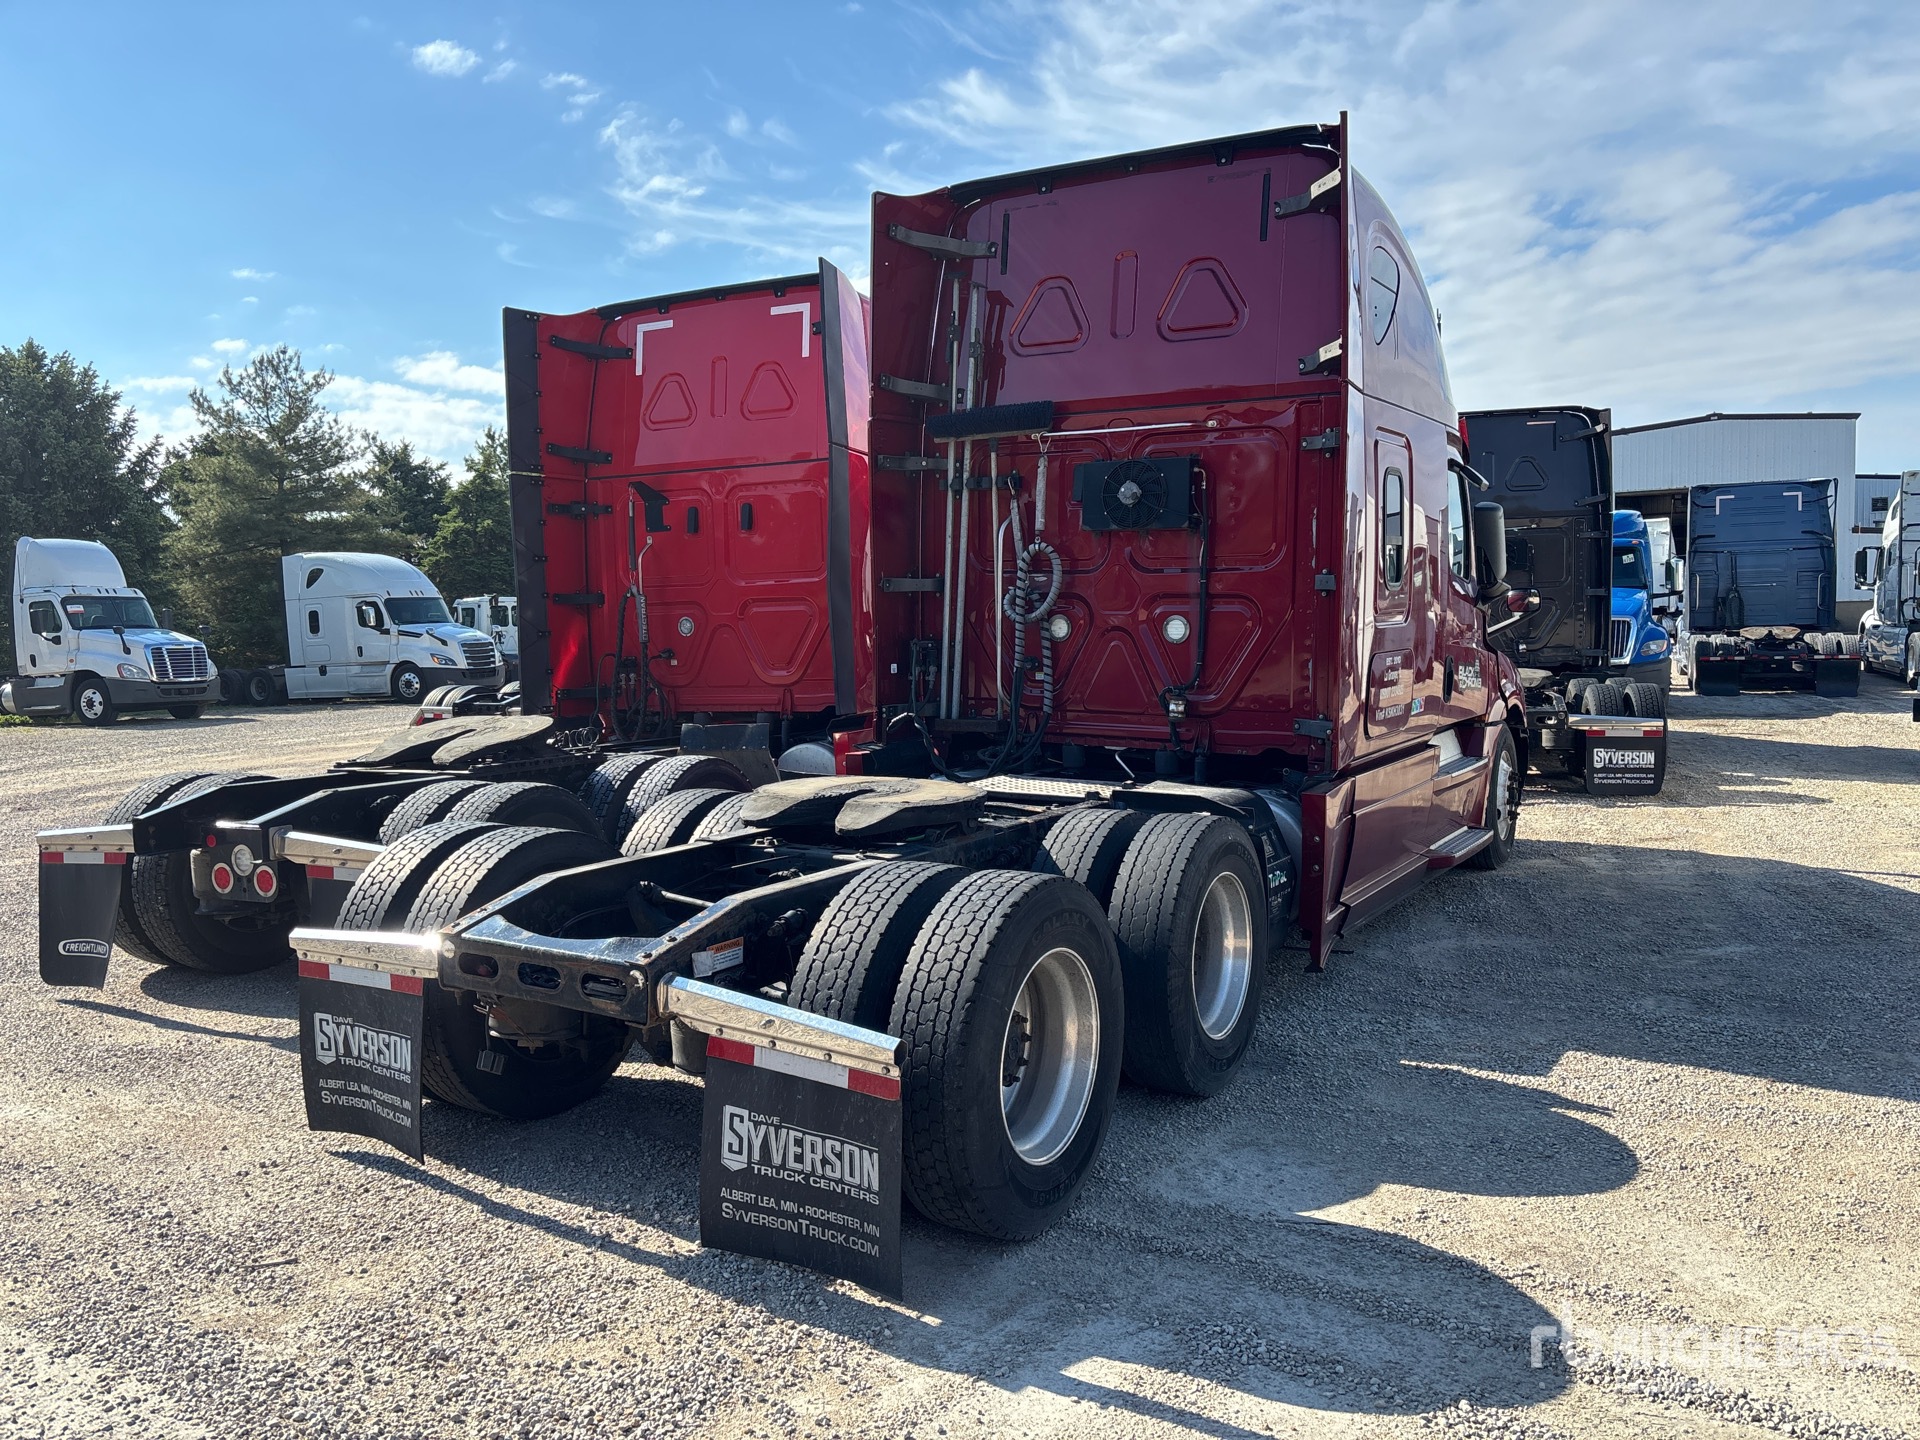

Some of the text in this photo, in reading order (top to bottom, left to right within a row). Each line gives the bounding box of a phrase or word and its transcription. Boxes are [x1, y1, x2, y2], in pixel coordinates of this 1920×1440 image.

[640, 596, 648, 635] TECTRAN
[1593, 748, 1655, 768] SYVERSON
[1032, 912, 1090, 946] GALAXY
[65, 942, 107, 954] FREIGHTLINER
[715, 940, 740, 952] WARNING
[332, 1015, 354, 1024] DAVE
[313, 1012, 411, 1074] SYVERSON
[338, 1056, 411, 1084] TRUCK CENTERS
[318, 1078, 345, 1090] ALBERT
[361, 1083, 371, 1095] MN
[402, 1099, 411, 1111] MN
[750, 1112, 781, 1126] DAVE
[721, 1104, 880, 1192] SYVERSON
[751, 1164, 880, 1206] TRUCK CENTERS
[720, 1187, 880, 1238] ALBERT LEA, MN ROCHESTER, MN
